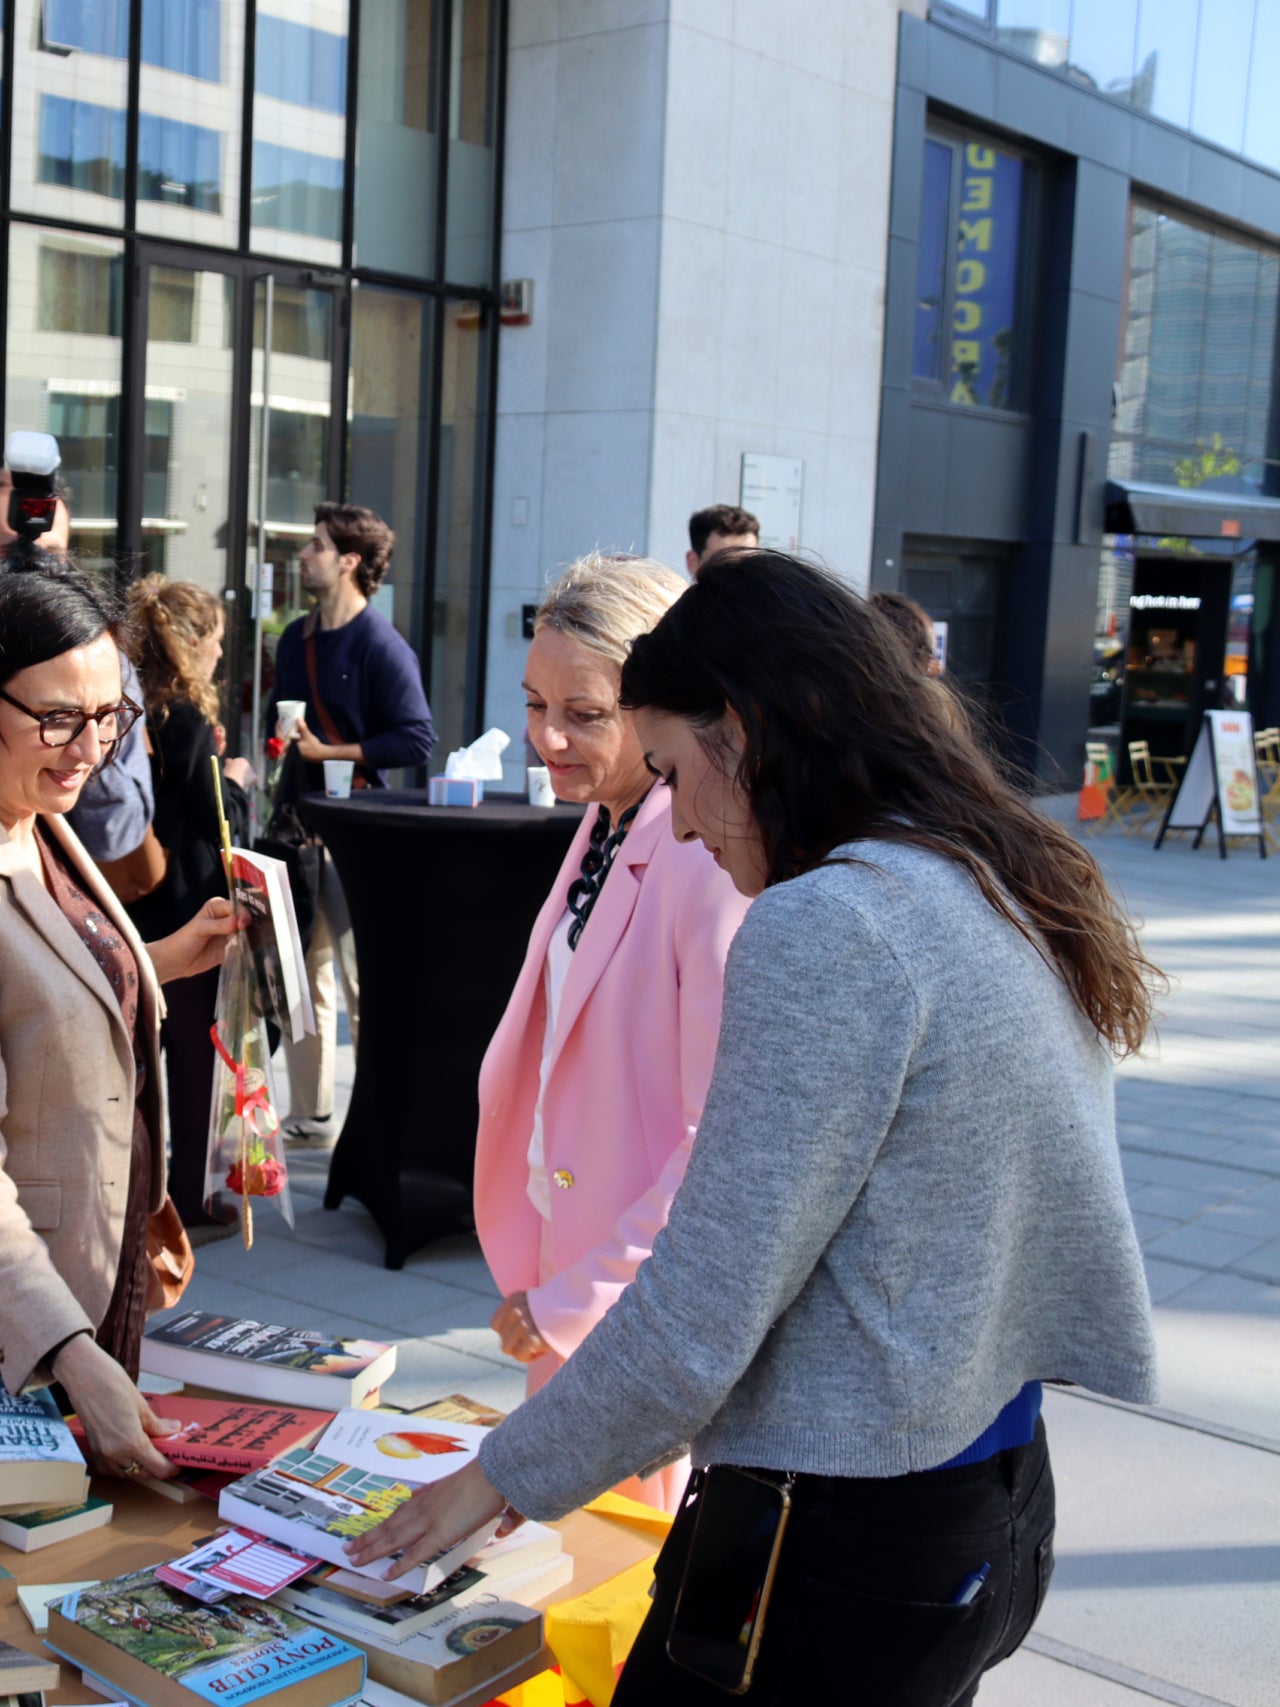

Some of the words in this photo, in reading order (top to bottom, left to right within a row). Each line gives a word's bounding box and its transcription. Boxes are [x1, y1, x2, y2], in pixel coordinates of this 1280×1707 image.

[230, 1642, 286, 1667] Stories
[272, 1636, 336, 1669] PONY
[208, 1663, 270, 1693] CLUB
